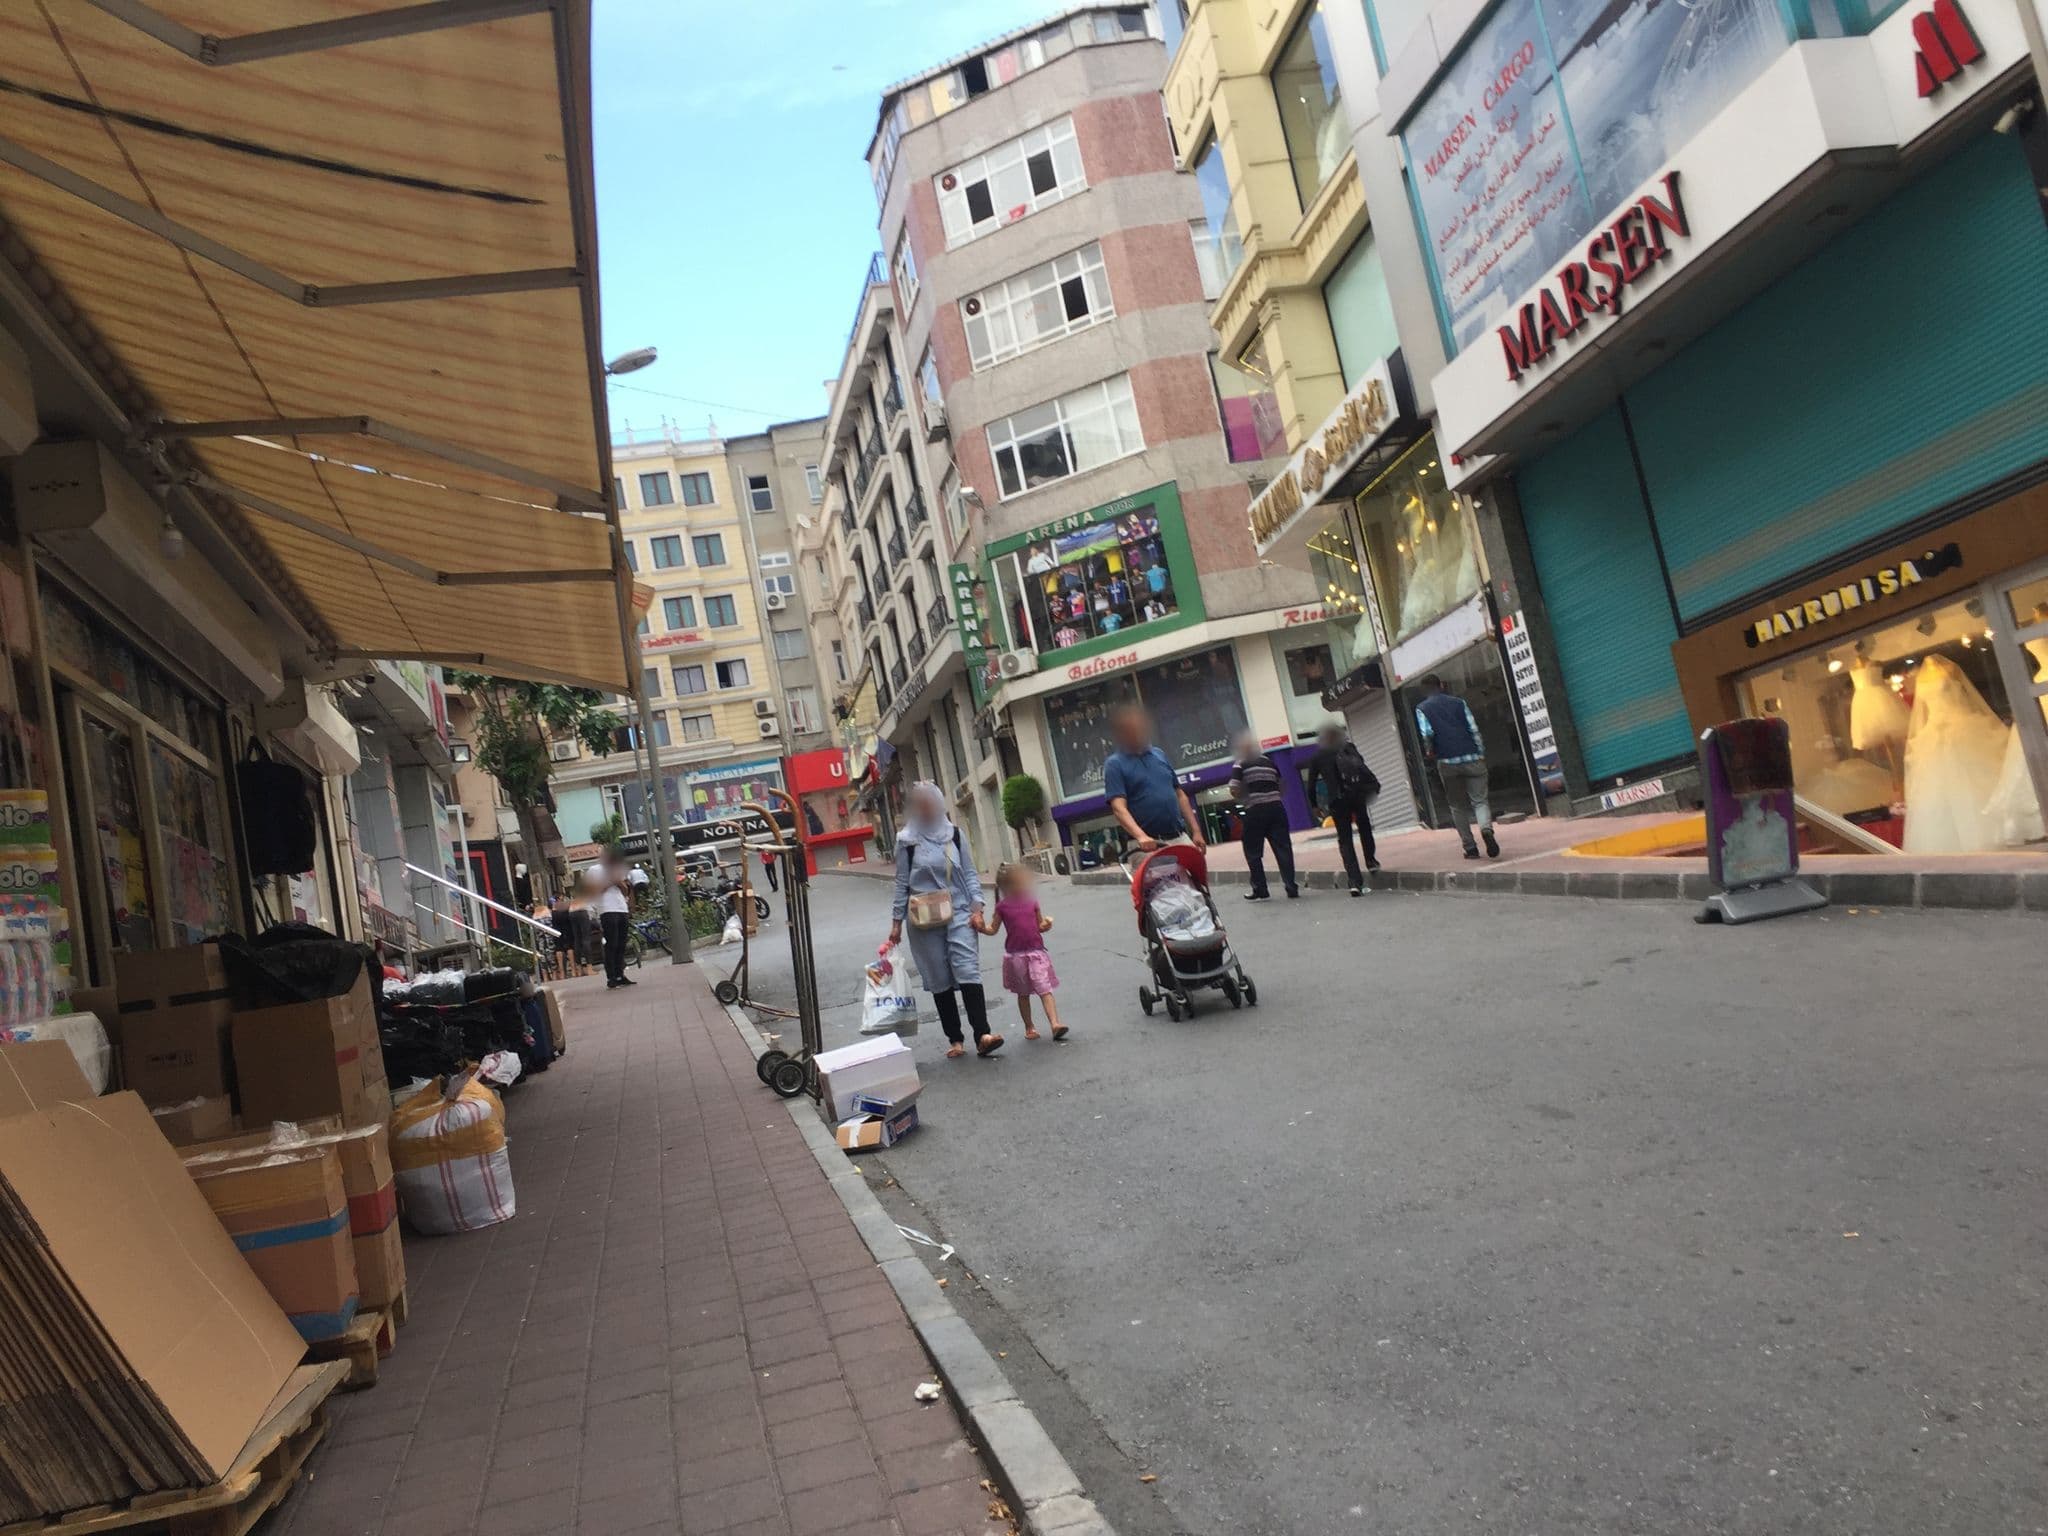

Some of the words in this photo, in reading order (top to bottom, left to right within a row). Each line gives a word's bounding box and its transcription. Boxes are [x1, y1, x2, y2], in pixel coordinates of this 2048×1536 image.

[1483, 39, 1535, 112] CARGO
[1497, 171, 1690, 382] MARŞEN
[1025, 511, 1095, 544] ARENA
[955, 570, 982, 648] ARENA
[702, 818, 771, 839] NOLNA
